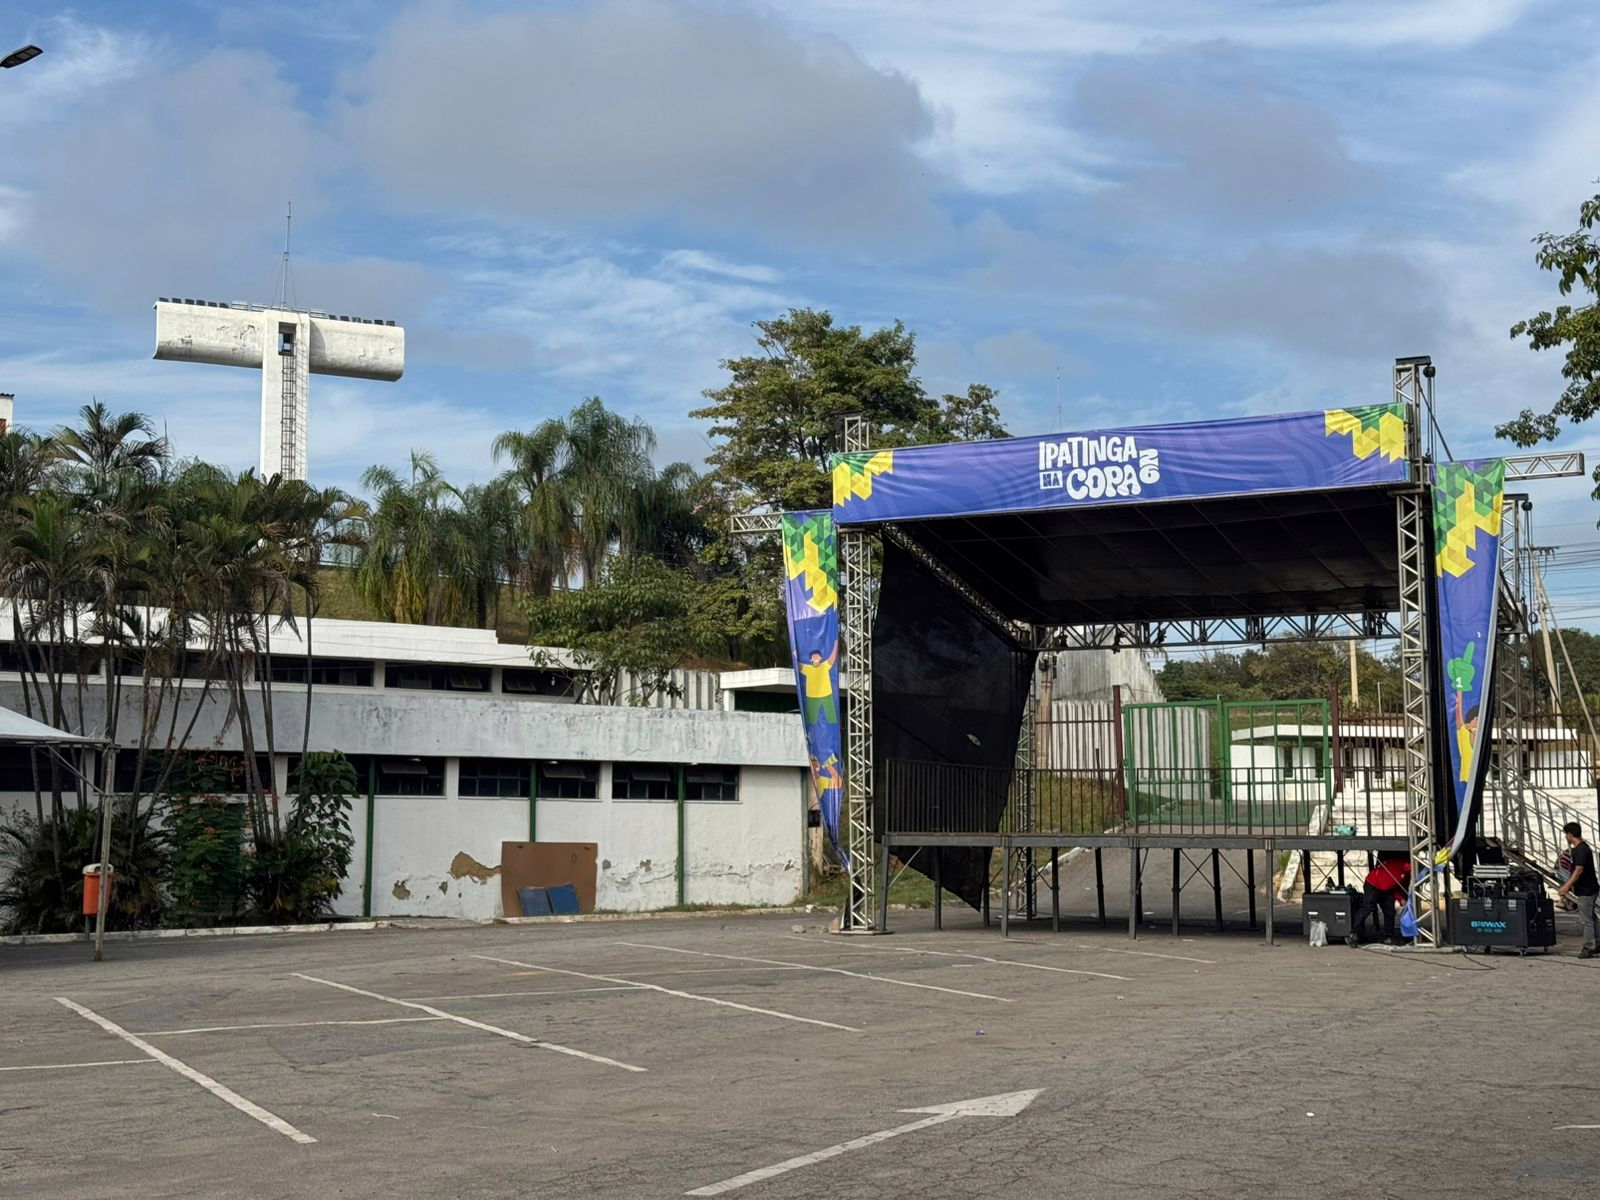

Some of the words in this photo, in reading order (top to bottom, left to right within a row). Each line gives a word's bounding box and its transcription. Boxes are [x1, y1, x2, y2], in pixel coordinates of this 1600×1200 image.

[1038, 436, 1138, 470] IPATINGA
[1041, 472, 1061, 488] NA
[1066, 464, 1142, 500] COPA
